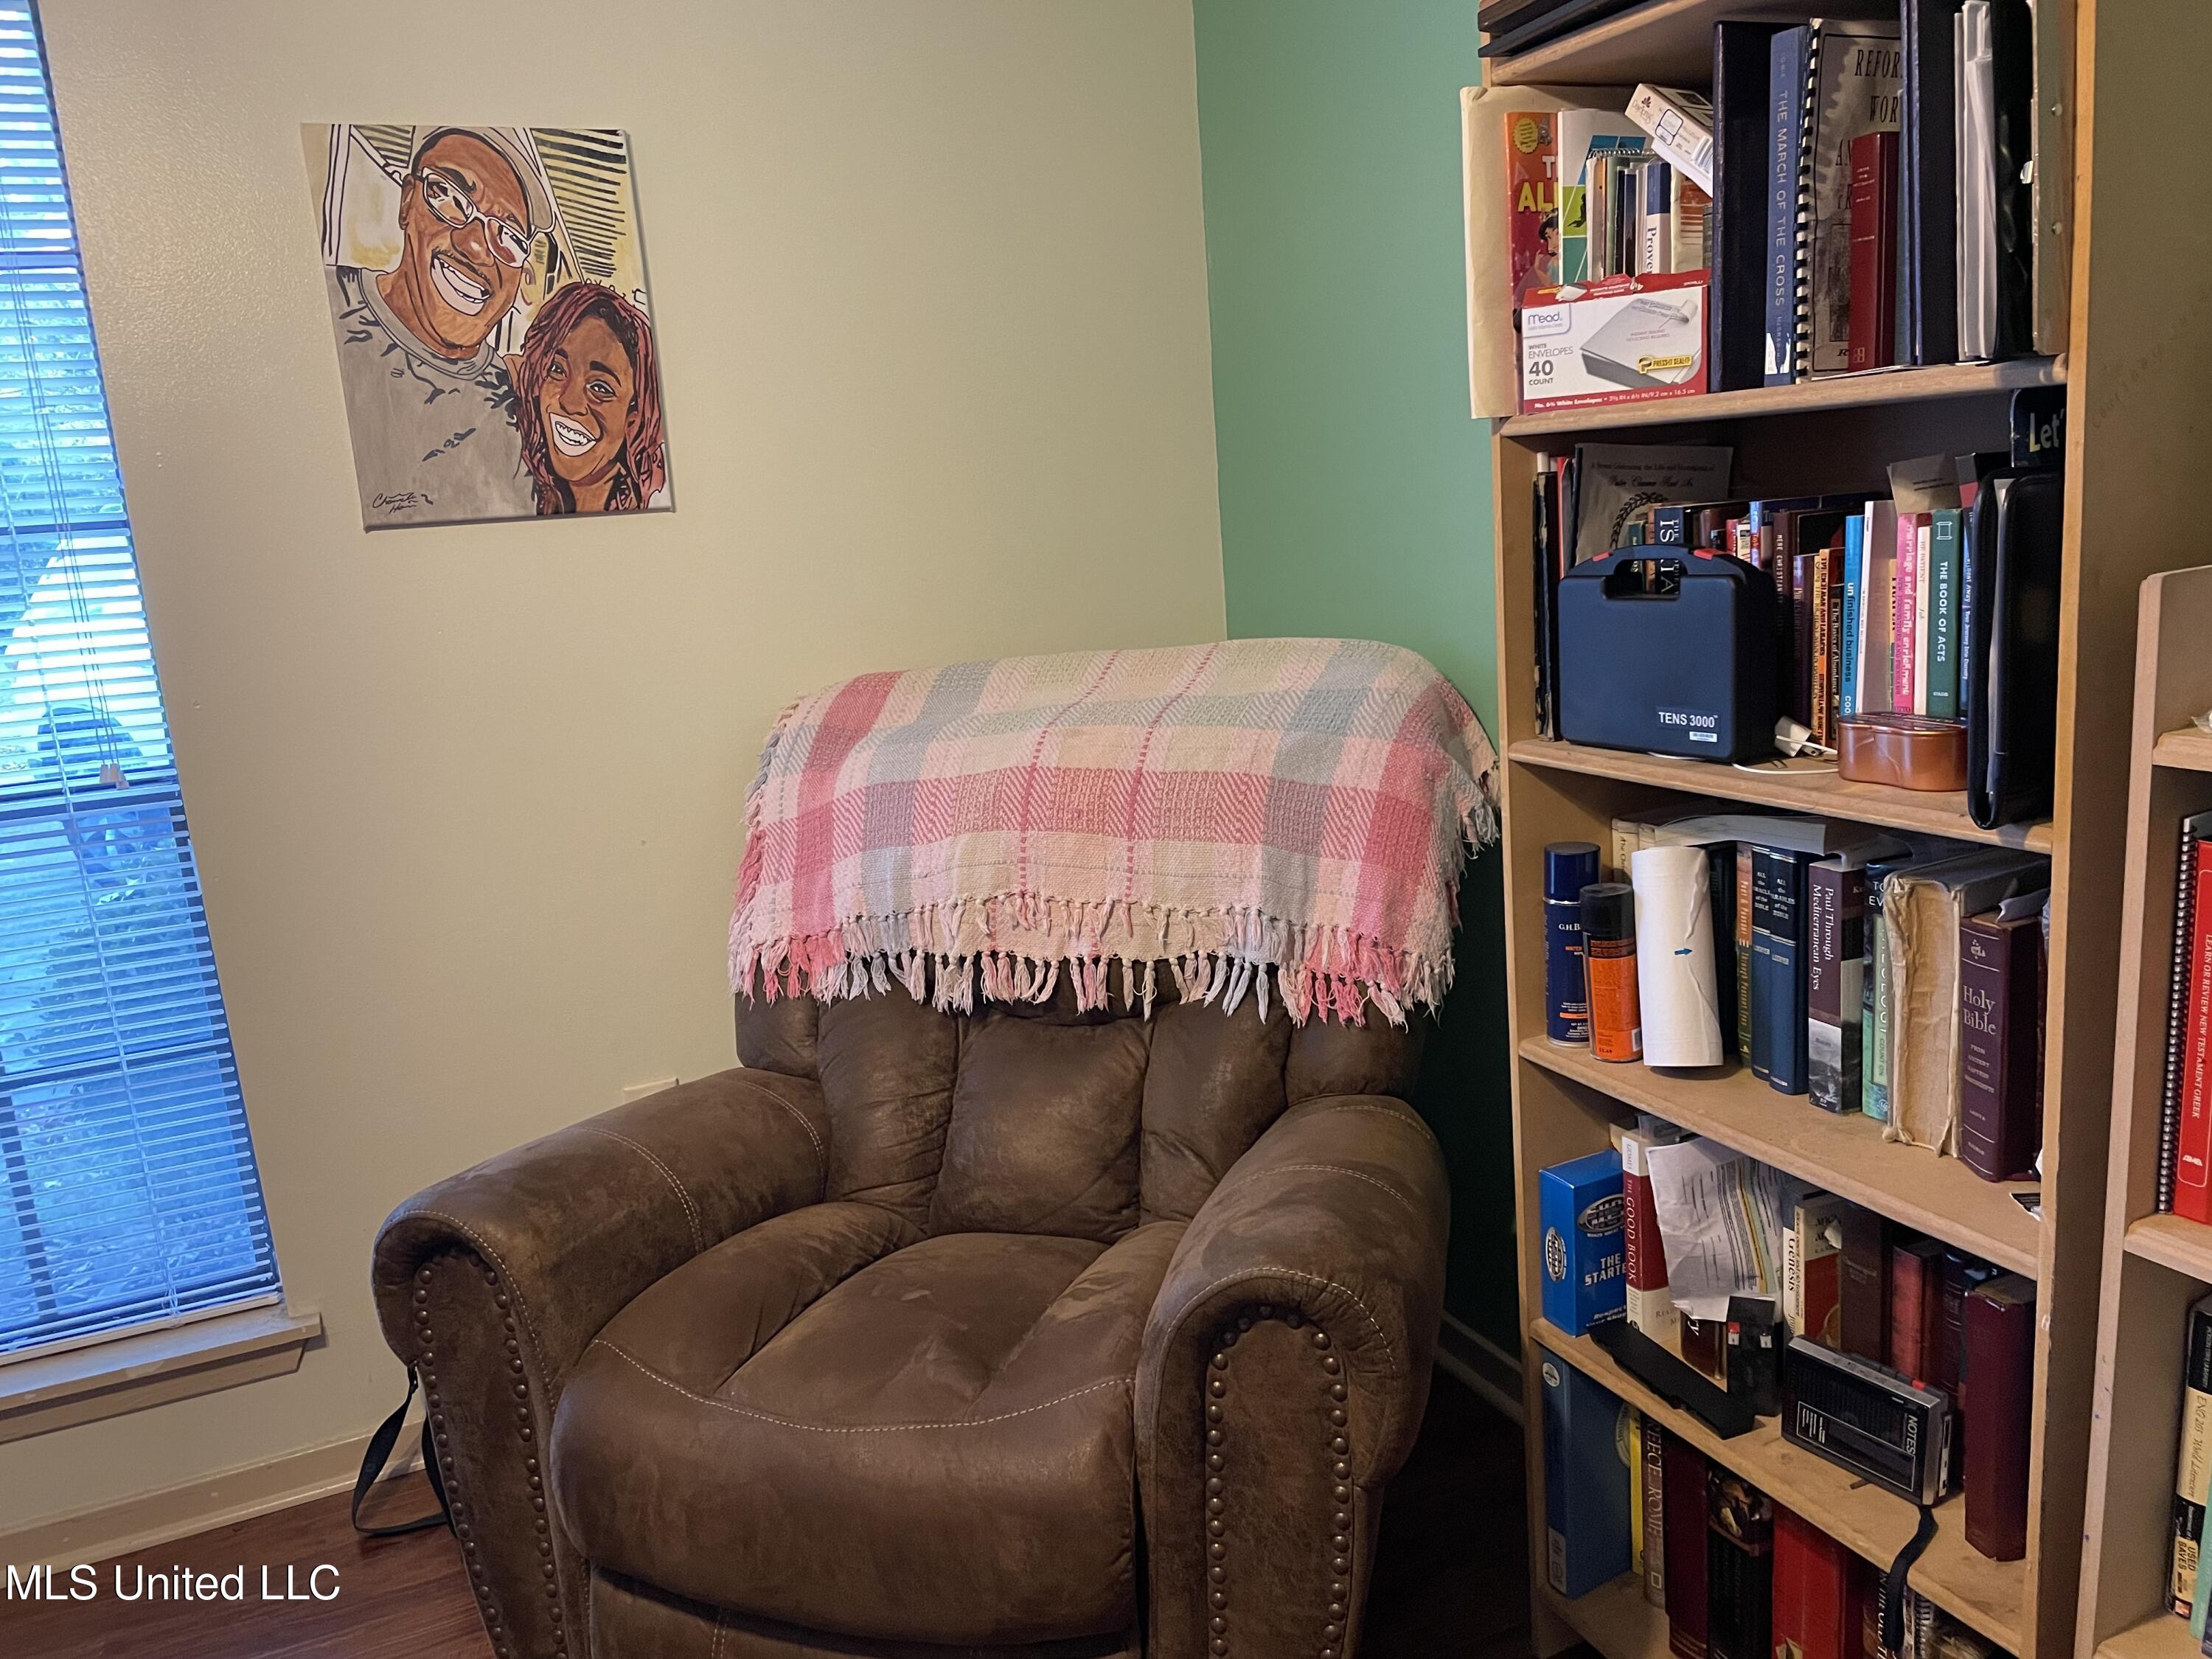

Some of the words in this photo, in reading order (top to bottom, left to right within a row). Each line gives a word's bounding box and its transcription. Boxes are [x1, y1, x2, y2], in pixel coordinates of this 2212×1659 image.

[1854, 49, 1902, 78] REFOR
[1777, 89, 1788, 123] THE
[1869, 95, 1899, 123] WOR
[1776, 128, 1787, 183] MARCH
[1776, 189, 1786, 210] OF
[1775, 215, 1786, 248] THE
[1775, 254, 1785, 306] CROSS
[1528, 346, 1573, 359] ENVELOPES
[1528, 360, 1554, 376] 40
[1528, 378, 1554, 386] COUNT
[2029, 408, 2065, 453] Let'
[1904, 524, 1915, 573] marriage
[1905, 576, 1913, 594] and
[1939, 560, 1948, 580] THE
[1845, 582, 1856, 637] unfinished
[1938, 583, 1948, 614] BOOK
[1902, 599, 1913, 633] family
[1938, 618, 1947, 633] OF
[1845, 640, 1855, 682] business
[1937, 636, 1947, 662] ACTS
[1831, 652, 1839, 692] Abundance
[1902, 636, 1913, 695] enrichment
[1658, 712, 1687, 726] TENS
[1825, 887, 1834, 911] Paul
[1812, 884, 1823, 963] Mediterranean
[1823, 913, 1834, 961] Through
[1811, 966, 1822, 990] Eyes
[2203, 964, 2211, 977] OR
[1964, 985, 1996, 1015] Holy
[2201, 978, 2210, 1014] REVIEW
[1964, 1008, 1997, 1035] Bible
[2199, 1015, 2208, 1034] NEW
[2194, 1037, 2206, 1088] TESTAMENT
[2191, 1089, 2201, 1119] GREEK
[1627, 1197, 1635, 1239] GOOD
[1585, 1262, 1627, 1286] STARTE
[1600, 1253, 1621, 1269] THE
[1628, 1243, 1636, 1282] BOOK
[1646, 1420, 1662, 1477] REECE
[1906, 1414, 1918, 1454] NOTES
[1647, 1485, 1663, 1535] ROME
[2187, 1545, 2197, 1571] USED
